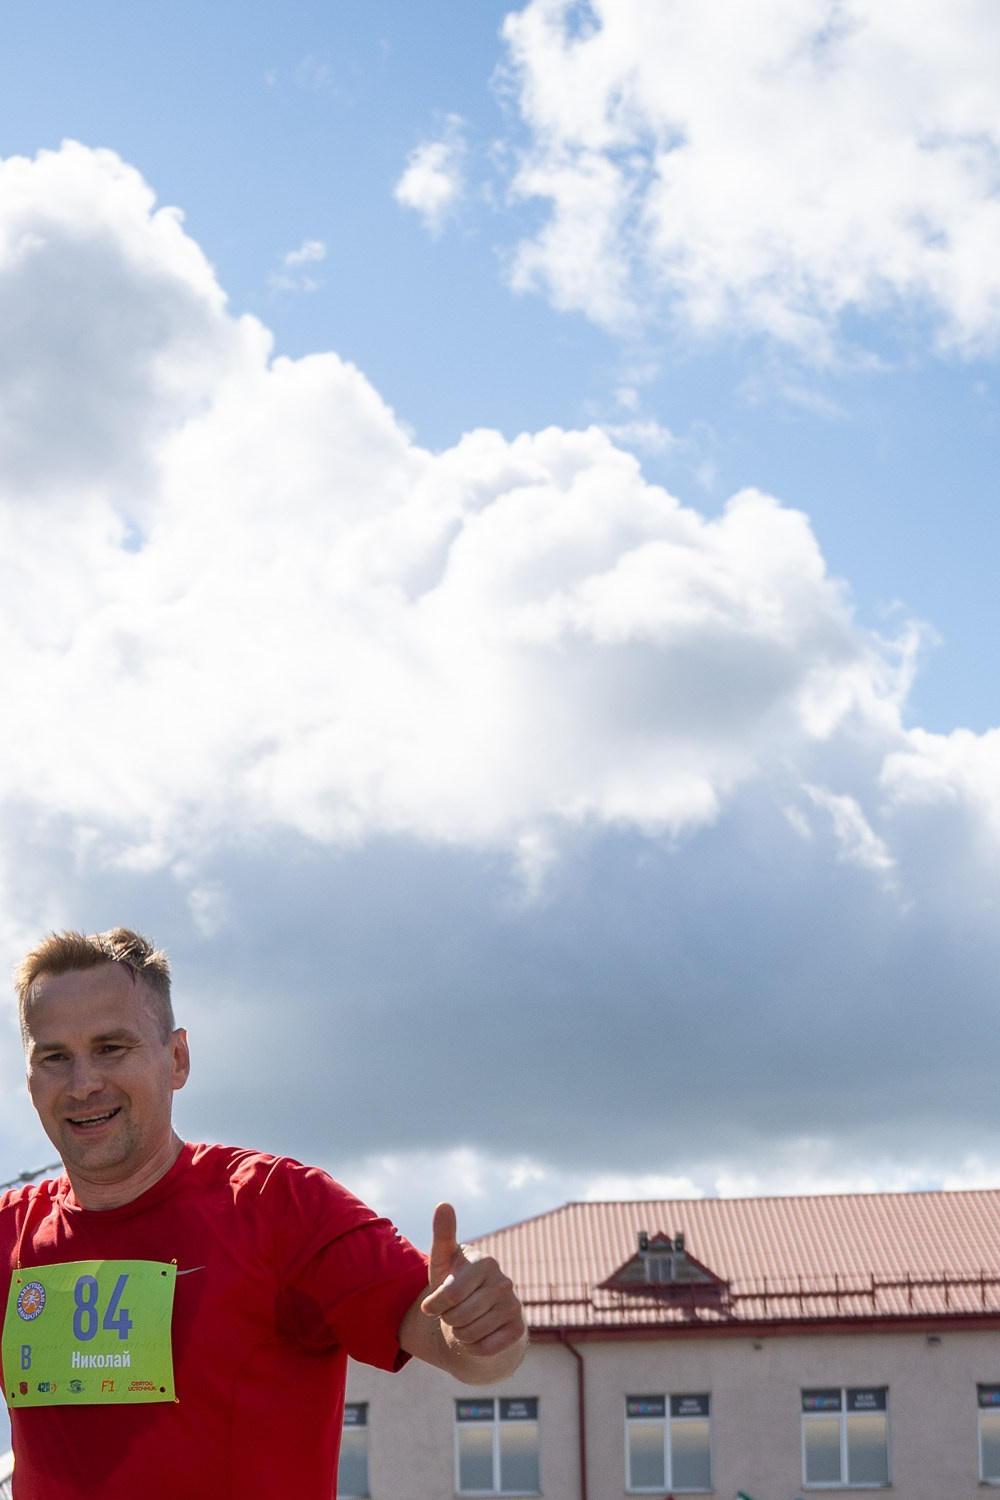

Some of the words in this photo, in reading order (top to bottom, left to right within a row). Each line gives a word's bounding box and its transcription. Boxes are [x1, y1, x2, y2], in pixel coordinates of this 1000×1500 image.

[73, 1275, 133, 1341] 84
[72, 1350, 131, 1368] Николай
[101, 1380, 115, 1392] F1
